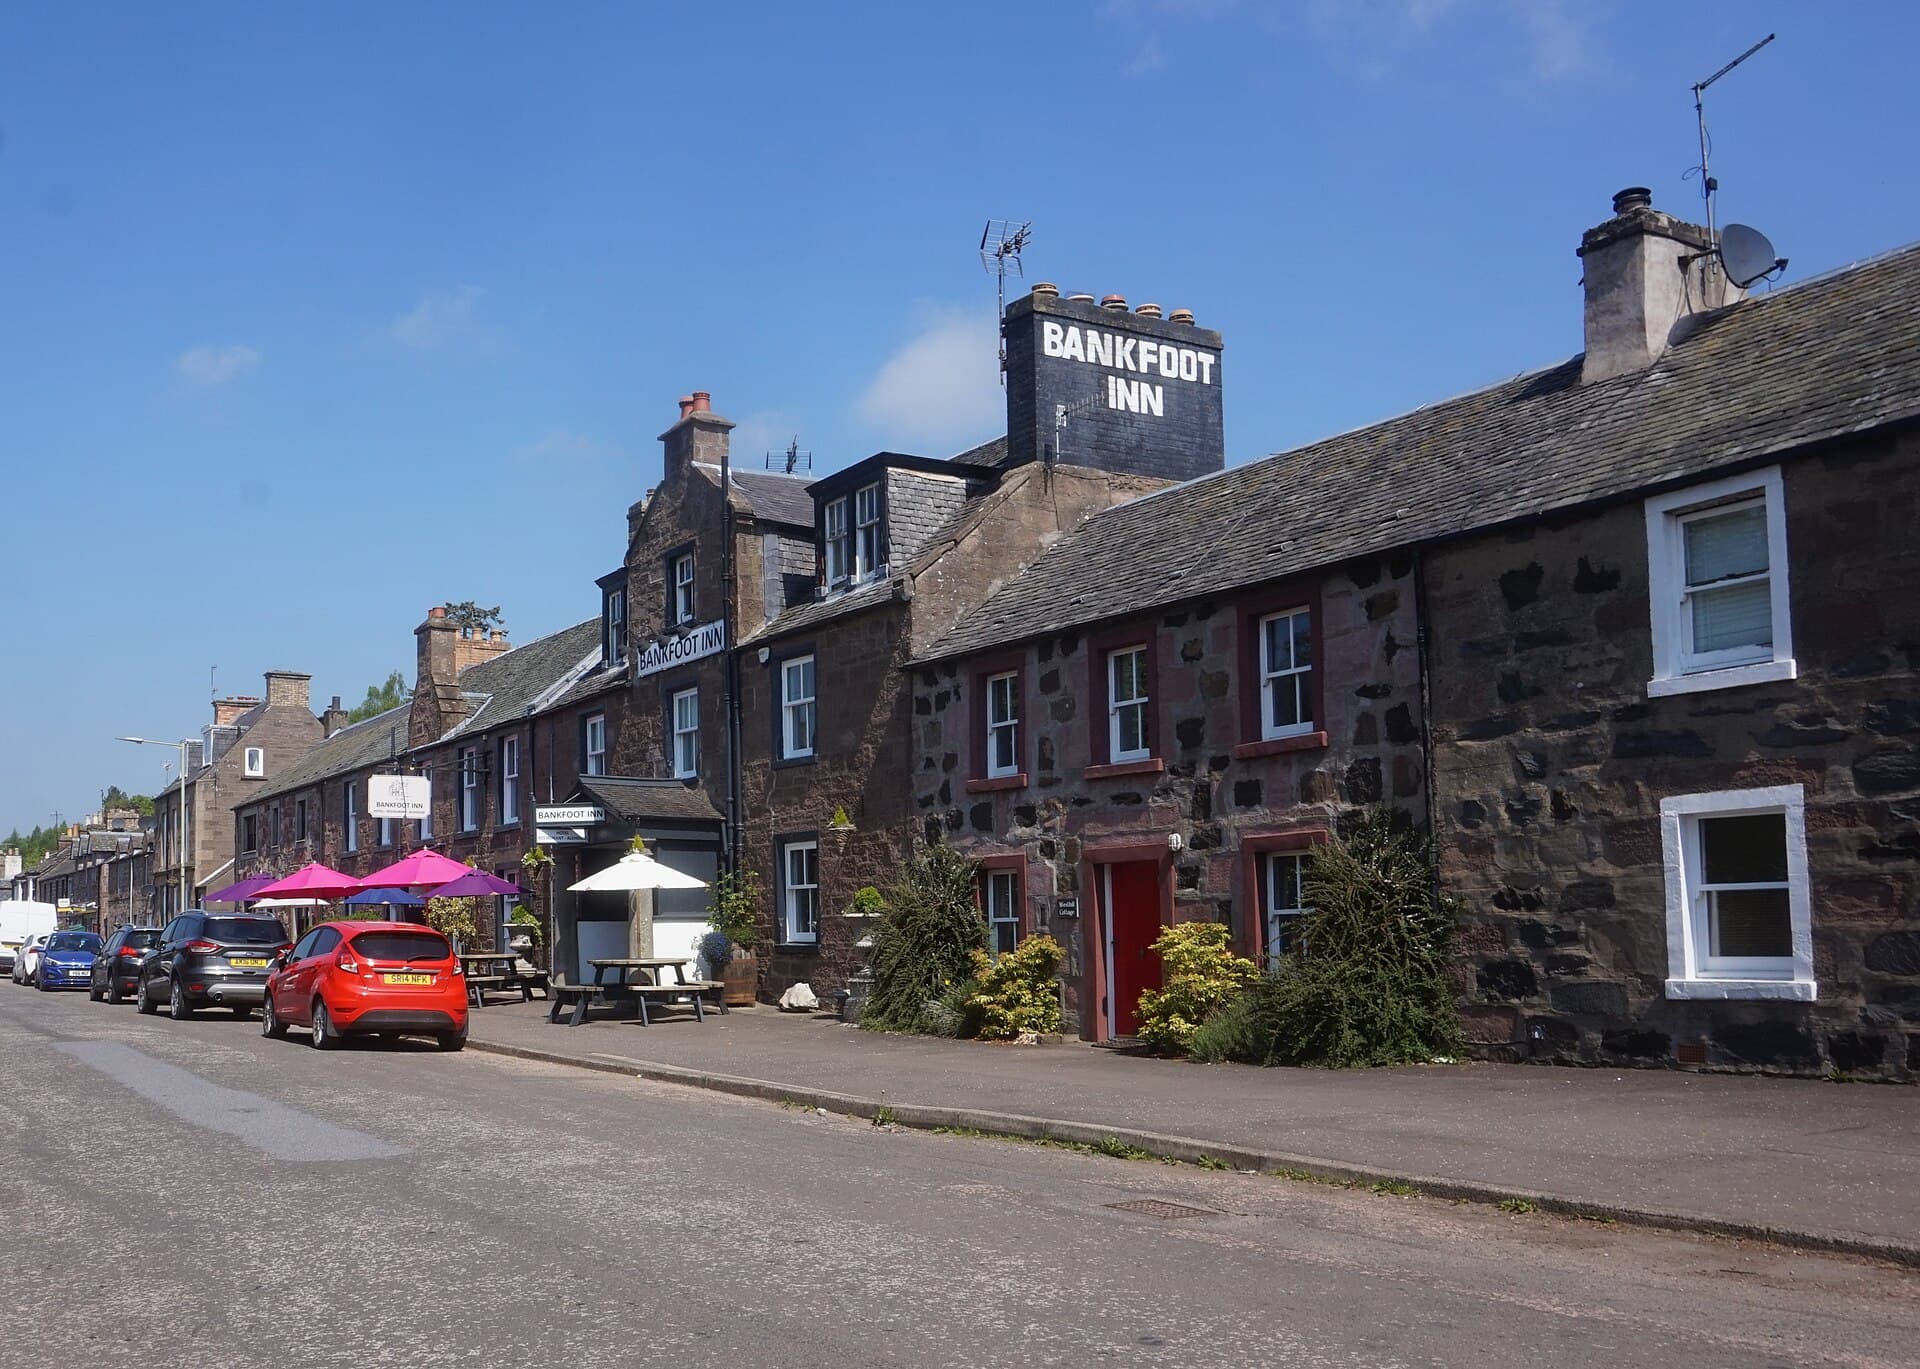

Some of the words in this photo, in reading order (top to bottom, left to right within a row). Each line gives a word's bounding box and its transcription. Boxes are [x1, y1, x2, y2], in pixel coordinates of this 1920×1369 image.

[1043, 320, 1215, 385] BANKFOOT
[1107, 375, 1164, 417] INN
[640, 634, 699, 671] BANKFOOT
[701, 626, 723, 652] INN
[376, 801, 410, 809] BANKFOOT
[538, 810, 585, 819] BANKFOOT
[587, 809, 603, 818] INN
[391, 974, 409, 983] SR14
[411, 975, 428, 984] NFK
